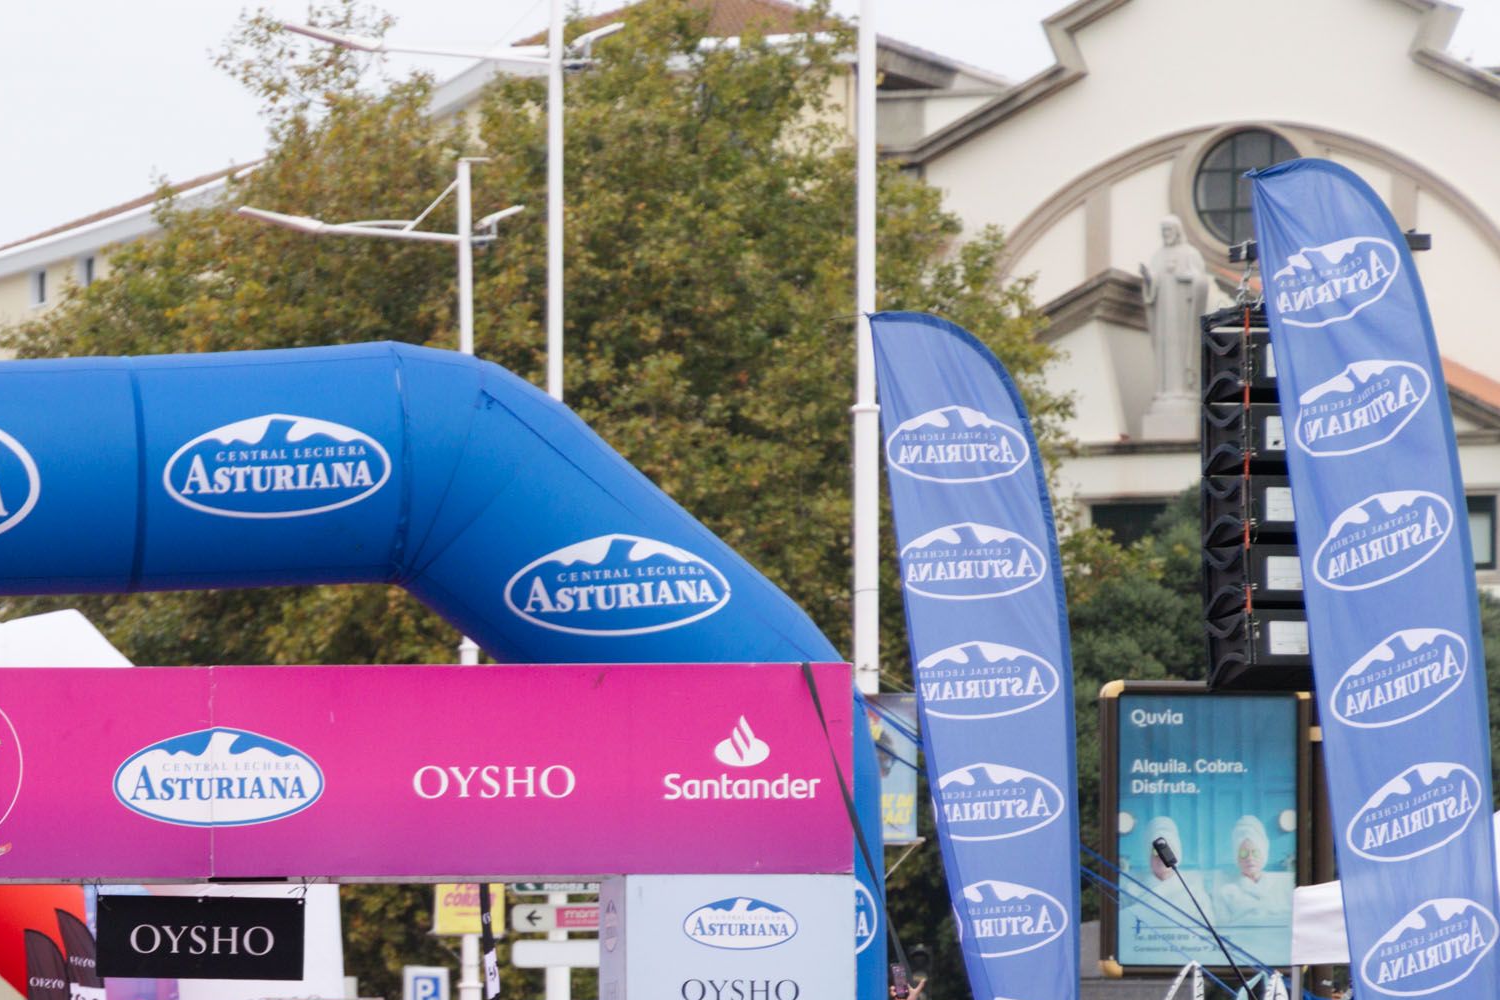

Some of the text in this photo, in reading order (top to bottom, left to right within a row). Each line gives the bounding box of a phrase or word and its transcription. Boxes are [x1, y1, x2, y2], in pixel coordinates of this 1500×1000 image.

[216, 445, 367, 461] CENTRAL LECHERA
[181, 454, 374, 494] ASTURIANA
[557, 565, 705, 582] CENTRAL LECHERA
[523, 576, 718, 613] ASTURIANA
[1130, 709, 1184, 726] Quvia
[162, 762, 301, 773] CENTRAL LECHERA
[1131, 758, 1248, 776] Alquila. Cobra.
[130, 764, 308, 801] ASTURIANA
[413, 765, 576, 799] OYSHO
[663, 773, 821, 802] Santander
[1131, 779, 1200, 794] Disfruta.
[692, 916, 791, 938] ASTURIANA
[129, 924, 275, 956] OYSHO
